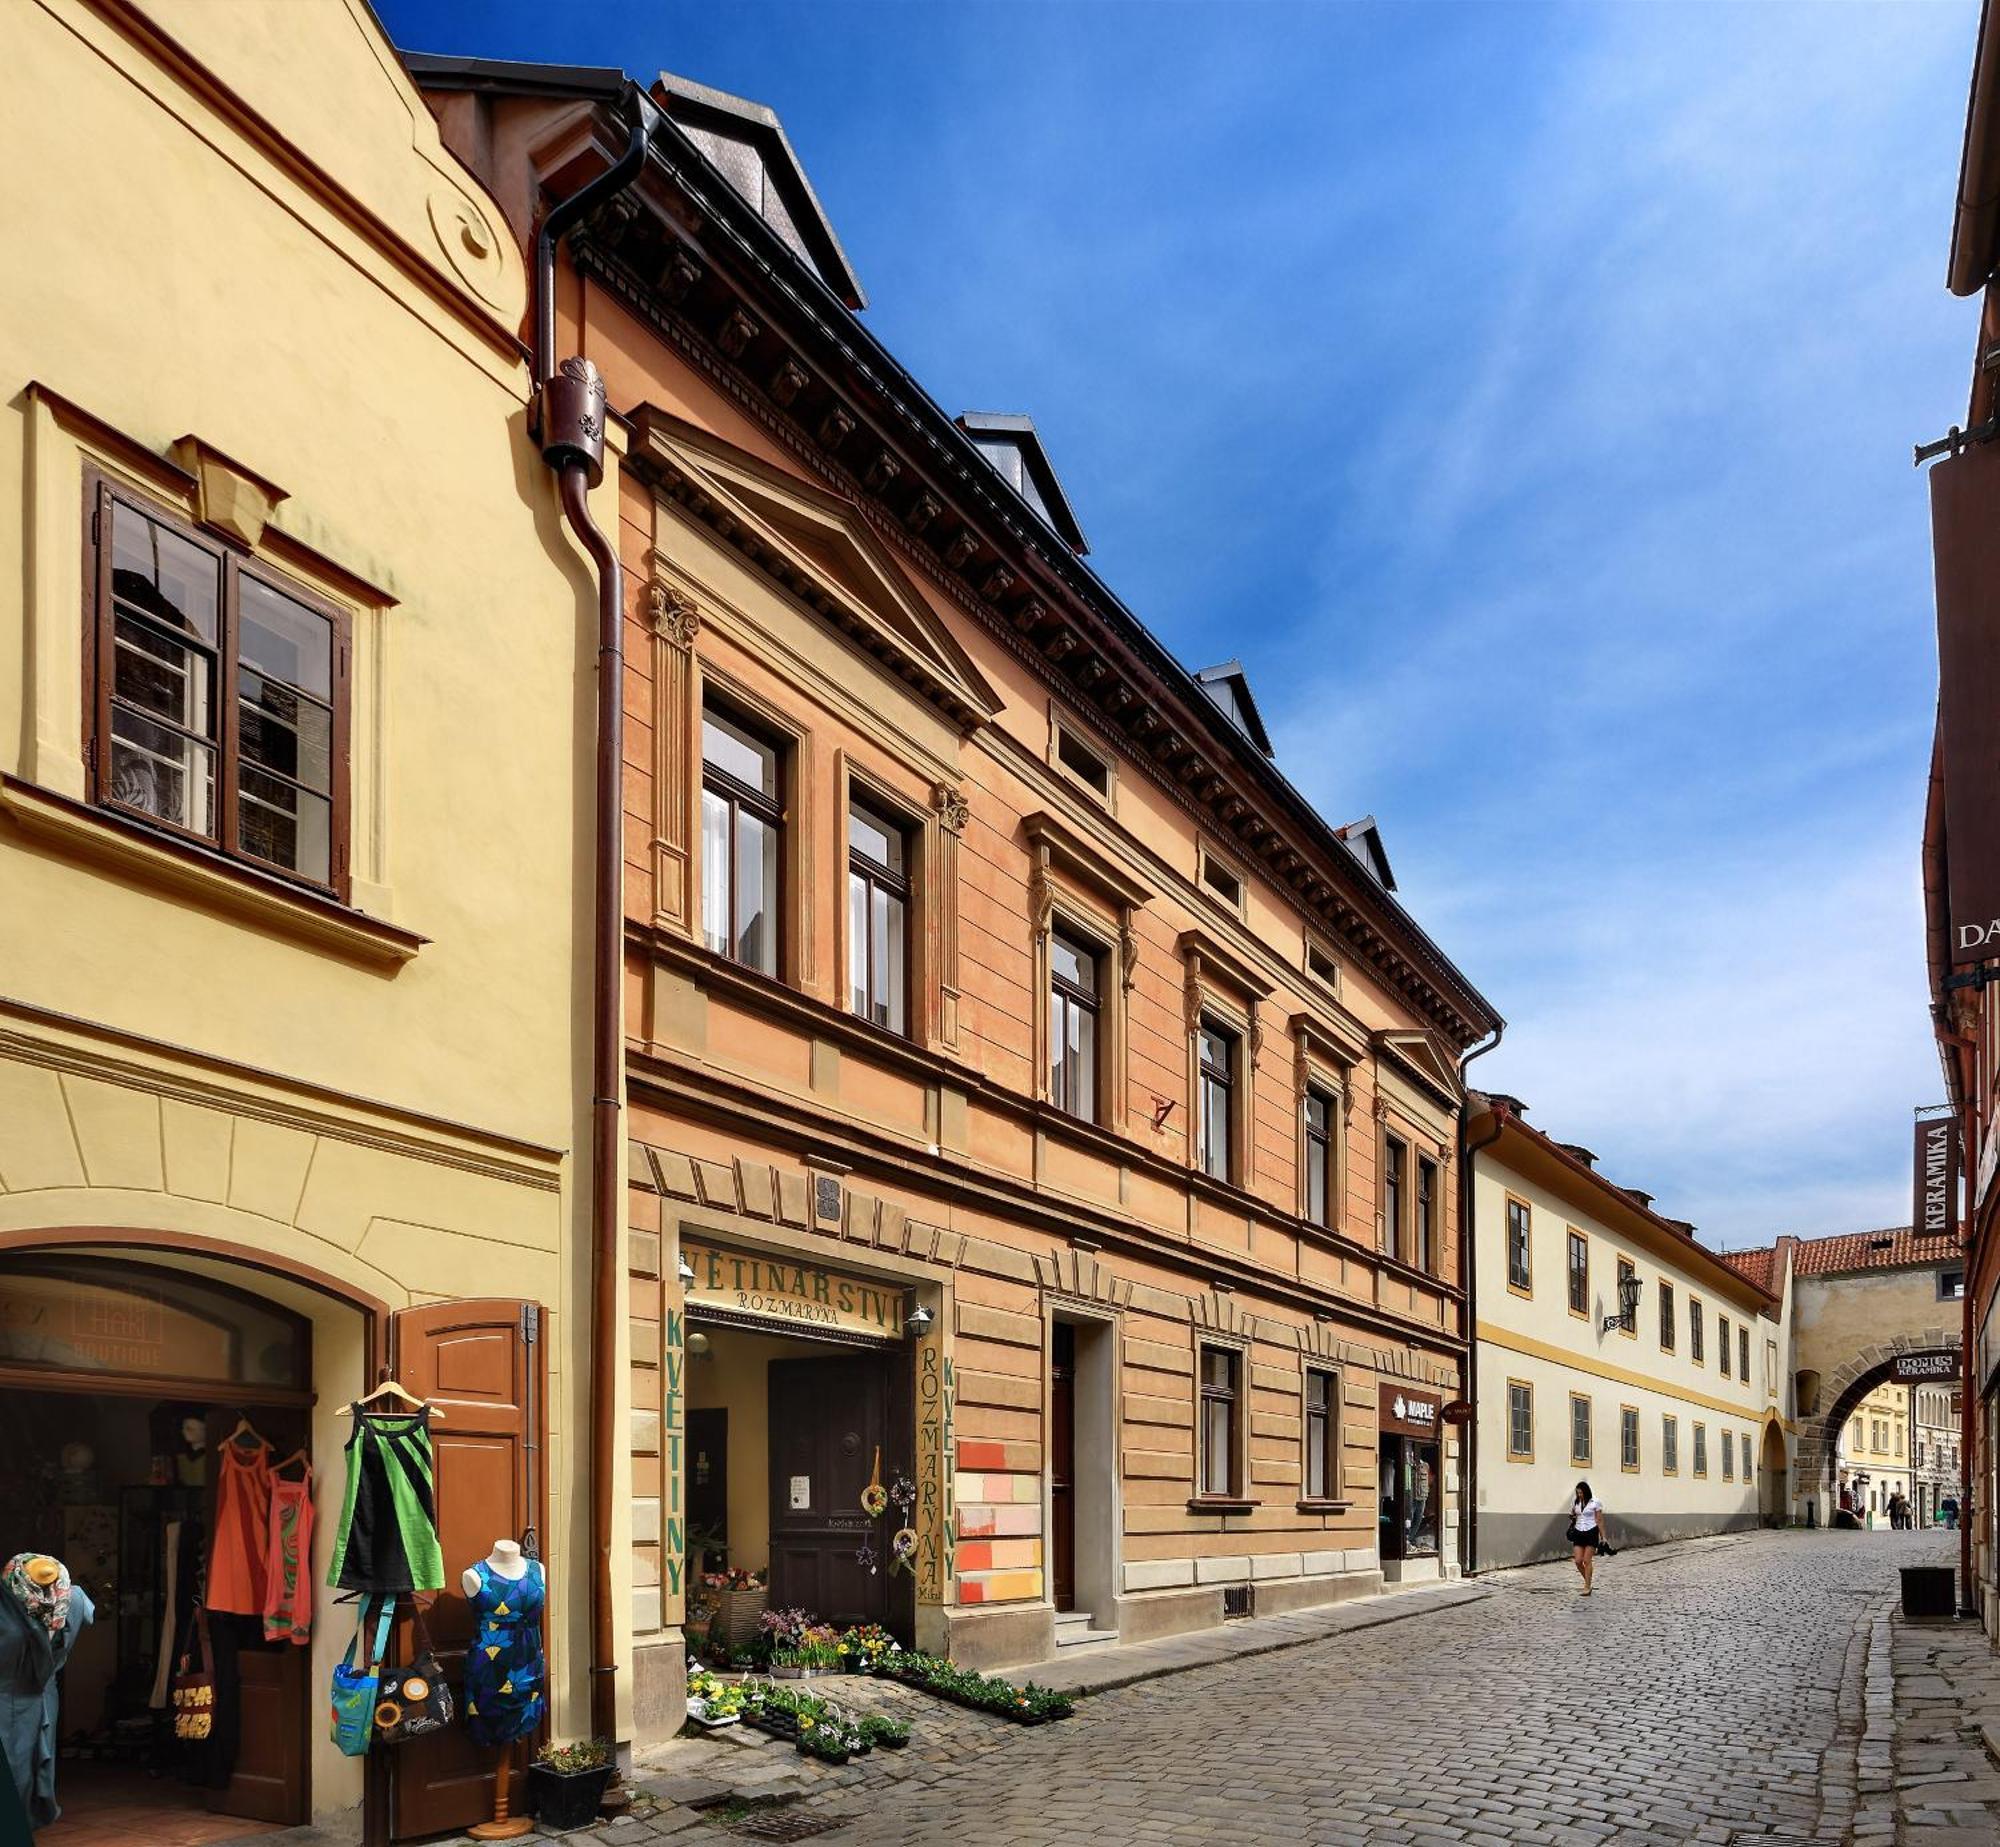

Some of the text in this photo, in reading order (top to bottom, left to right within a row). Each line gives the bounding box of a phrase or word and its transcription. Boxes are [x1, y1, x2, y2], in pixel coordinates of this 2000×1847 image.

[1926, 1124, 1948, 1231] KERAMIKA
[74, 1341, 161, 1367] BOUTIQUE
[1896, 1355, 1952, 1369] DOMUS
[1898, 1365, 1951, 1376] KERAMIKA
[1407, 1399, 1435, 1420] MAPLE
[666, 1308, 684, 1596] KVĚTINY
[943, 1355, 955, 1581] KVĚTINY
